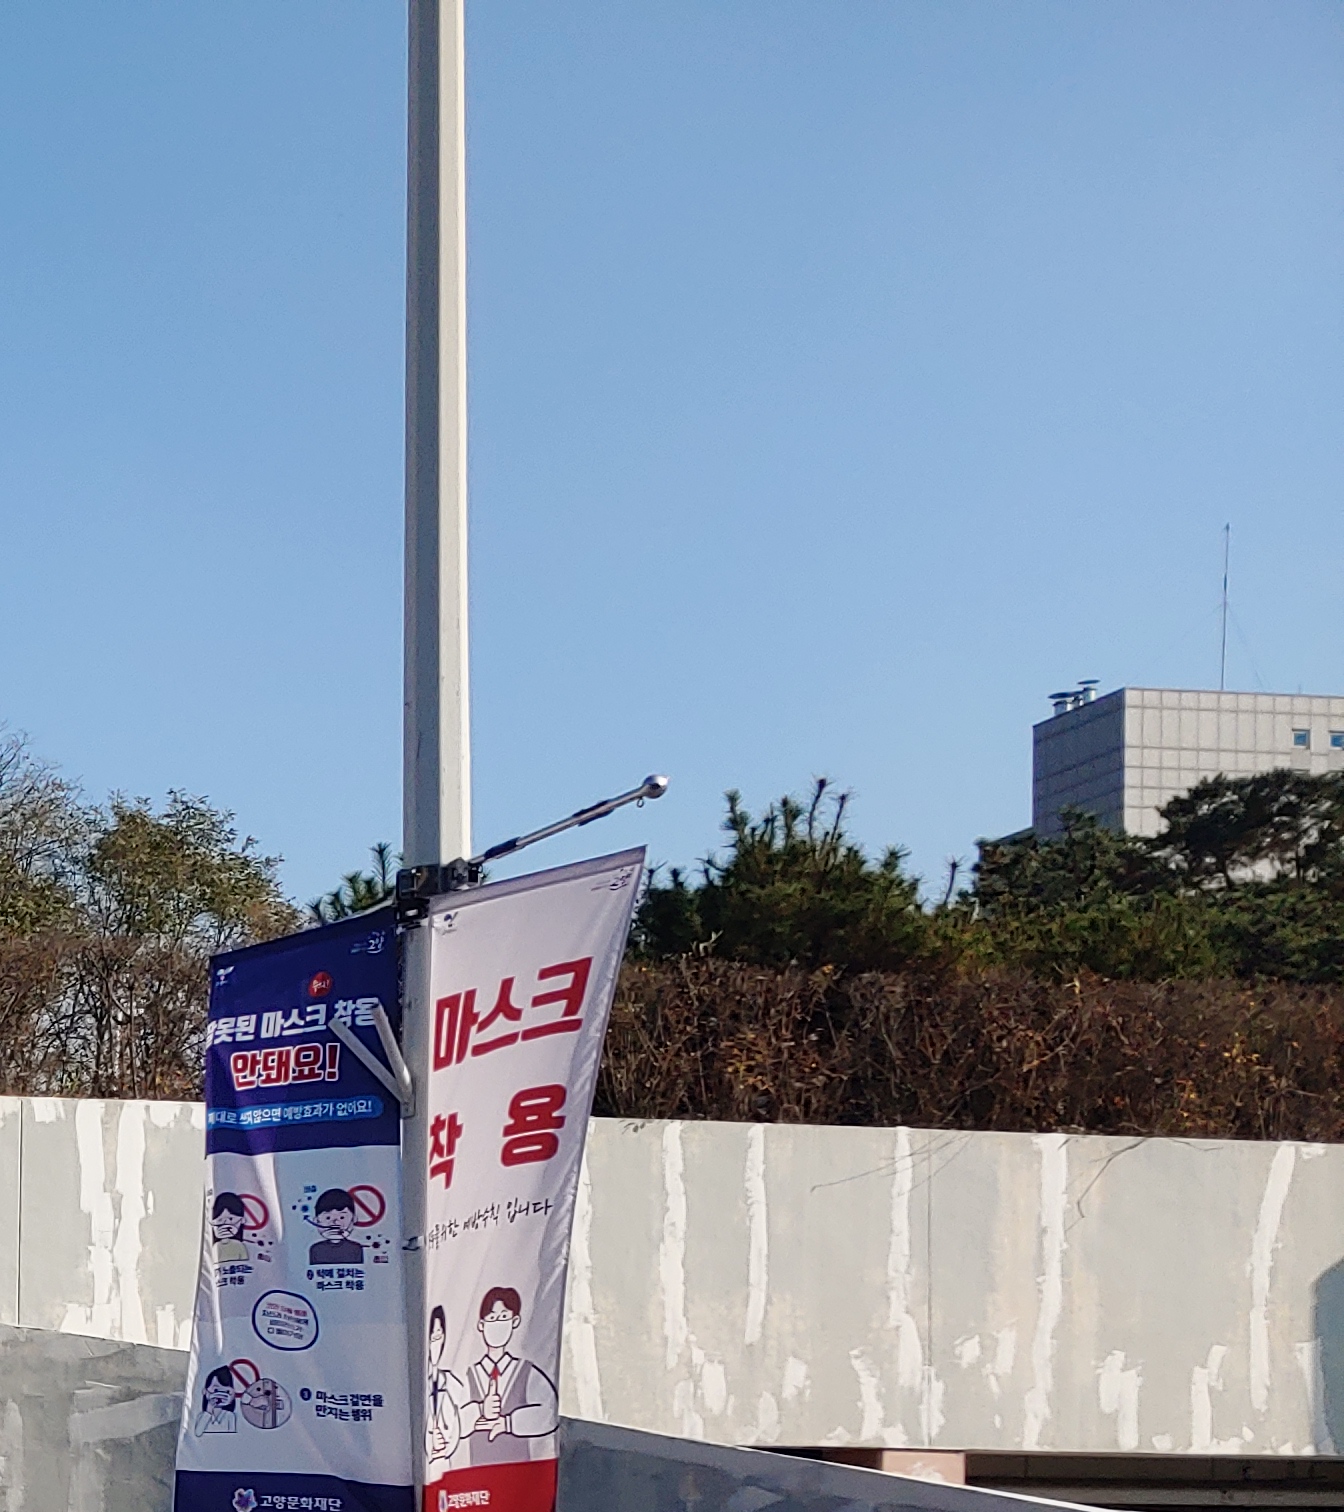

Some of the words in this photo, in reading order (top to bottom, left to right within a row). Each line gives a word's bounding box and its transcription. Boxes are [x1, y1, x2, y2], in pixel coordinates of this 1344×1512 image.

[261, 1004, 327, 1039] 마스크
[433, 956, 594, 1072] 마스크
[231, 1043, 340, 1091] 안돼요!
[507, 1197, 553, 1223] 입니다
[259, 1494, 342, 1512] 고양문화재단
